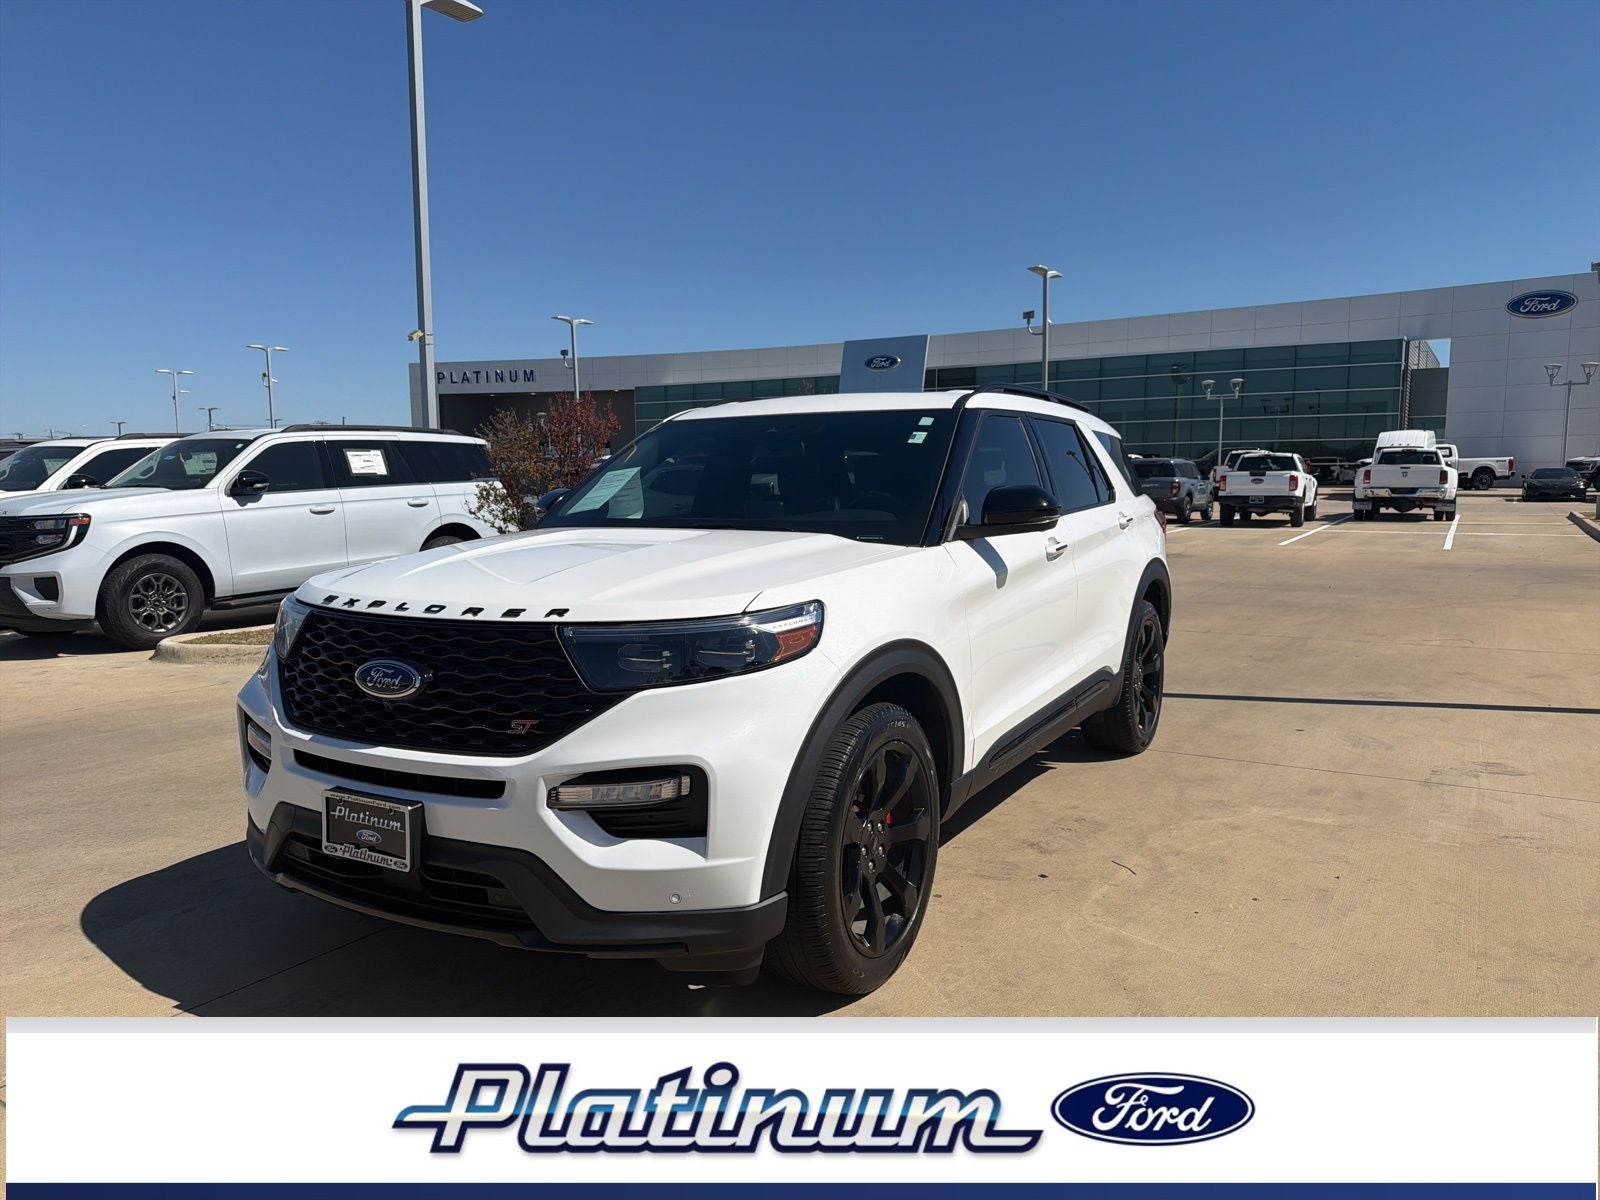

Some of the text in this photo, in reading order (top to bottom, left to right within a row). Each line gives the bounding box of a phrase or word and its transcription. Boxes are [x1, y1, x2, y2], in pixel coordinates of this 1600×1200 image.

[1520, 297, 1561, 313] Ford
[437, 369, 535, 384] PLATINUM
[321, 594, 570, 618] EXPLORER
[366, 666, 407, 690] Ford
[507, 719, 540, 735] ST
[330, 806, 405, 833] Platinum
